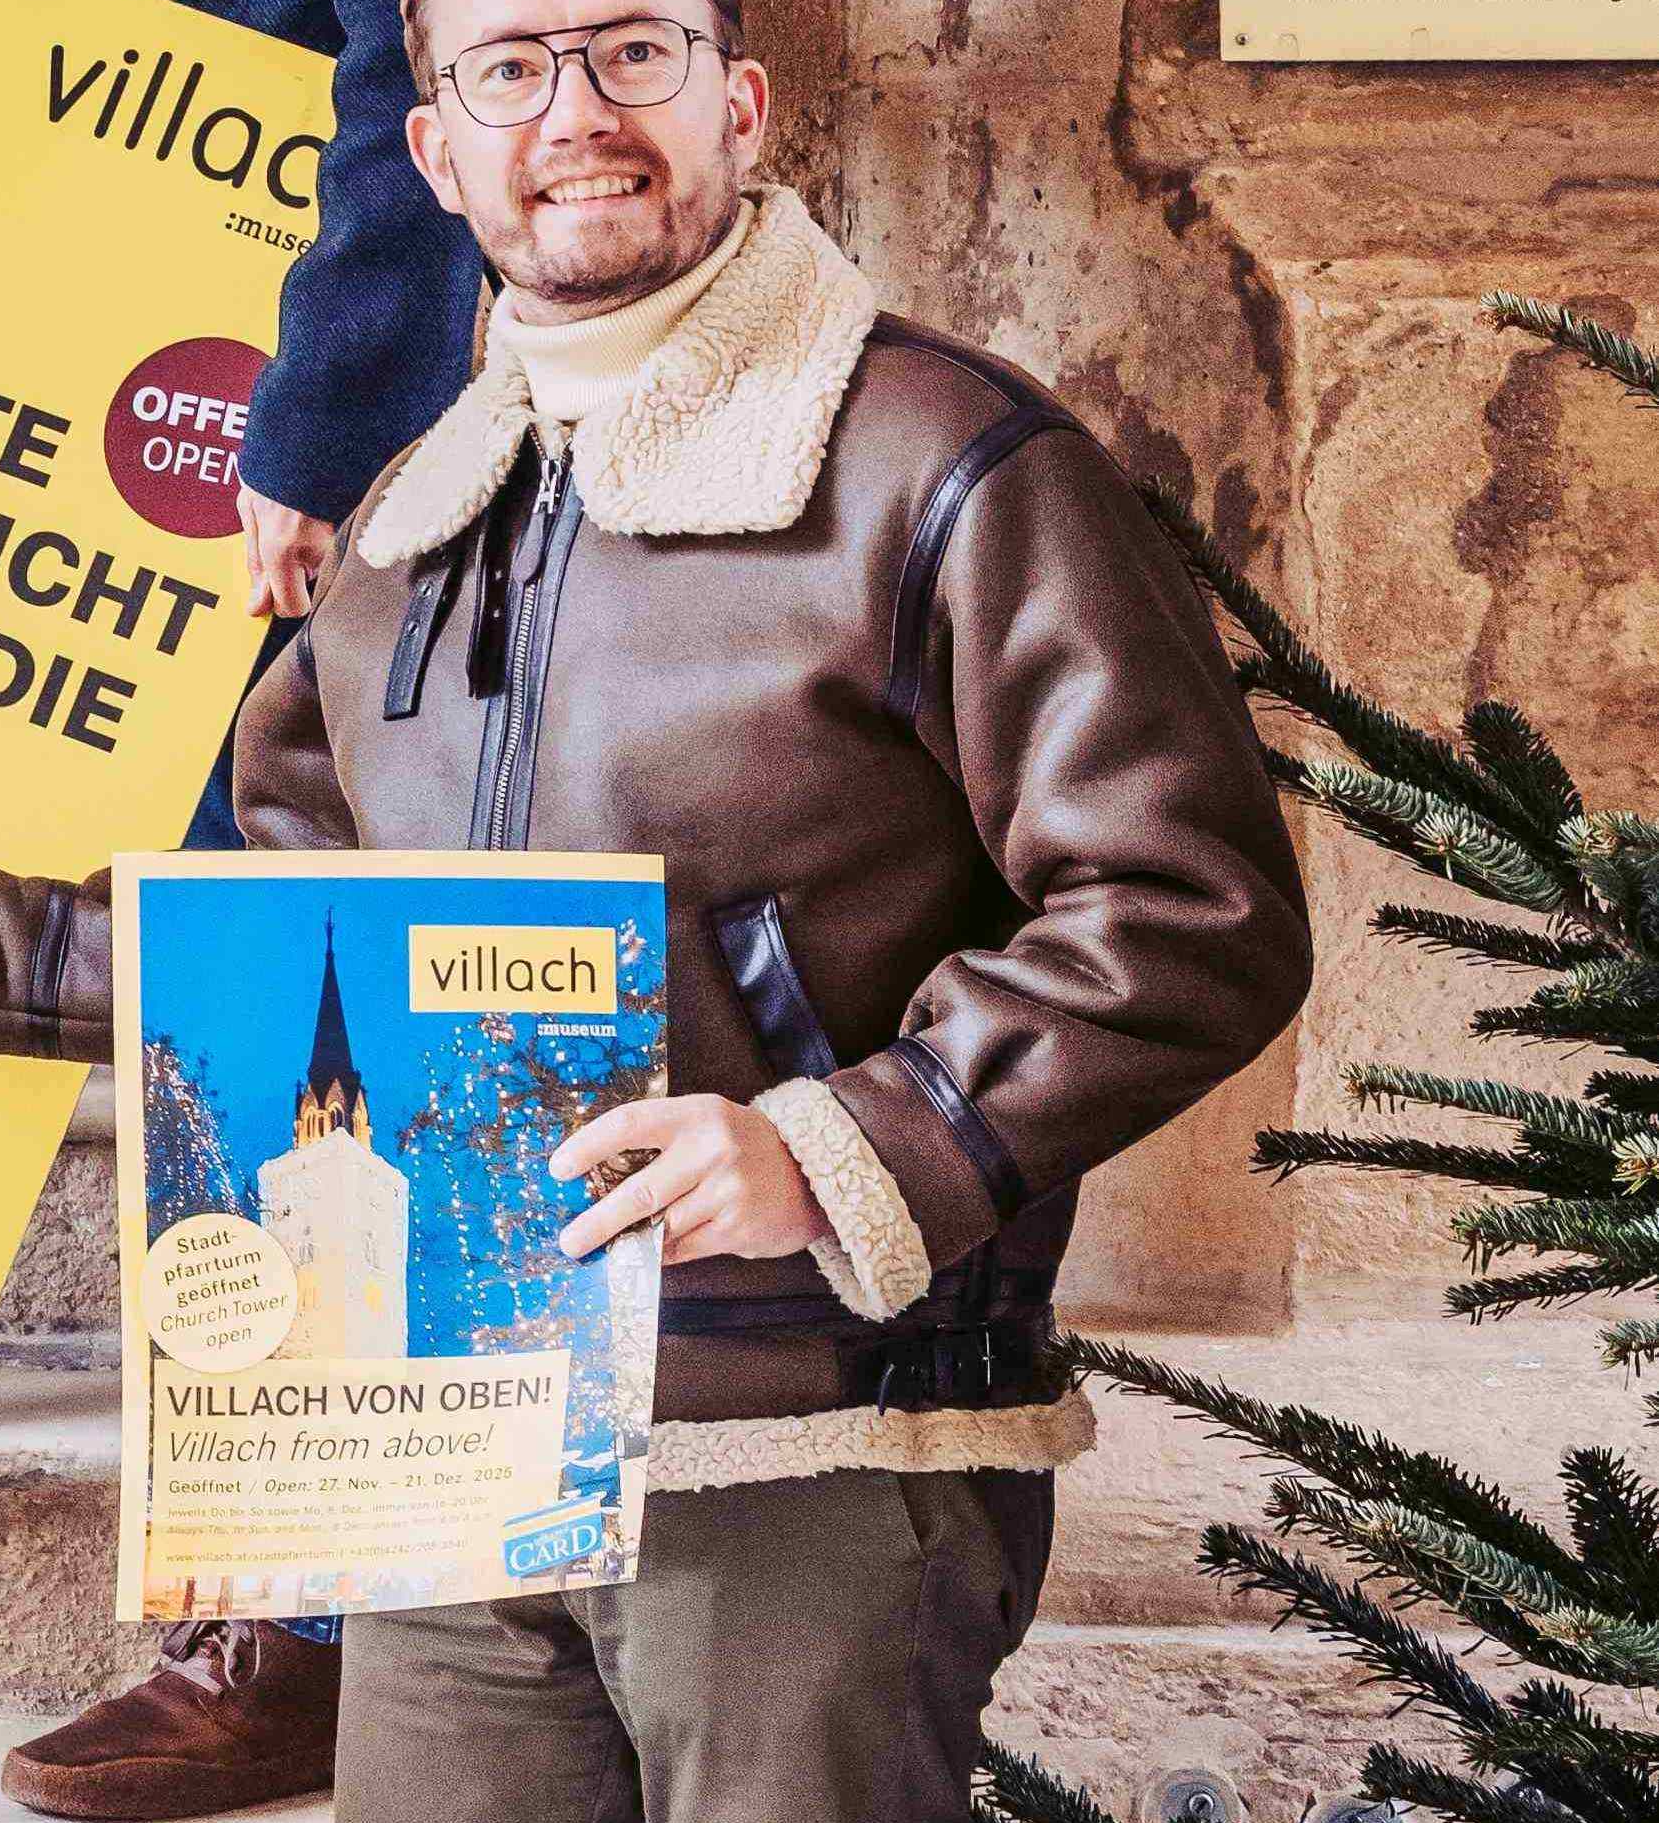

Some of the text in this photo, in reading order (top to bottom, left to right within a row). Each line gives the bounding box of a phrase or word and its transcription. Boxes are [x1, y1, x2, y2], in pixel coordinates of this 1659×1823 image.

[47, 43, 329, 210] villac
[225, 212, 314, 257] :muse
[132, 385, 250, 440] OFFE
[430, 945, 597, 994] villach
[537, 1023, 618, 1037] :museum
[176, 1230, 238, 1254] Stadt-
[163, 1250, 263, 1286] pfarrturm
[176, 1273, 261, 1308] geöffnet
[160, 1294, 289, 1333] Church Tower
[205, 1326, 252, 1350] open
[166, 1375, 554, 1417] VILLACH VON OBEN!
[169, 1423, 496, 1464] Villach from above!
[168, 1479, 242, 1495] Geöffnet
[264, 1477, 314, 1497] Open:
[347, 1476, 383, 1492] Nov.
[509, 1524, 598, 1571] CARD
